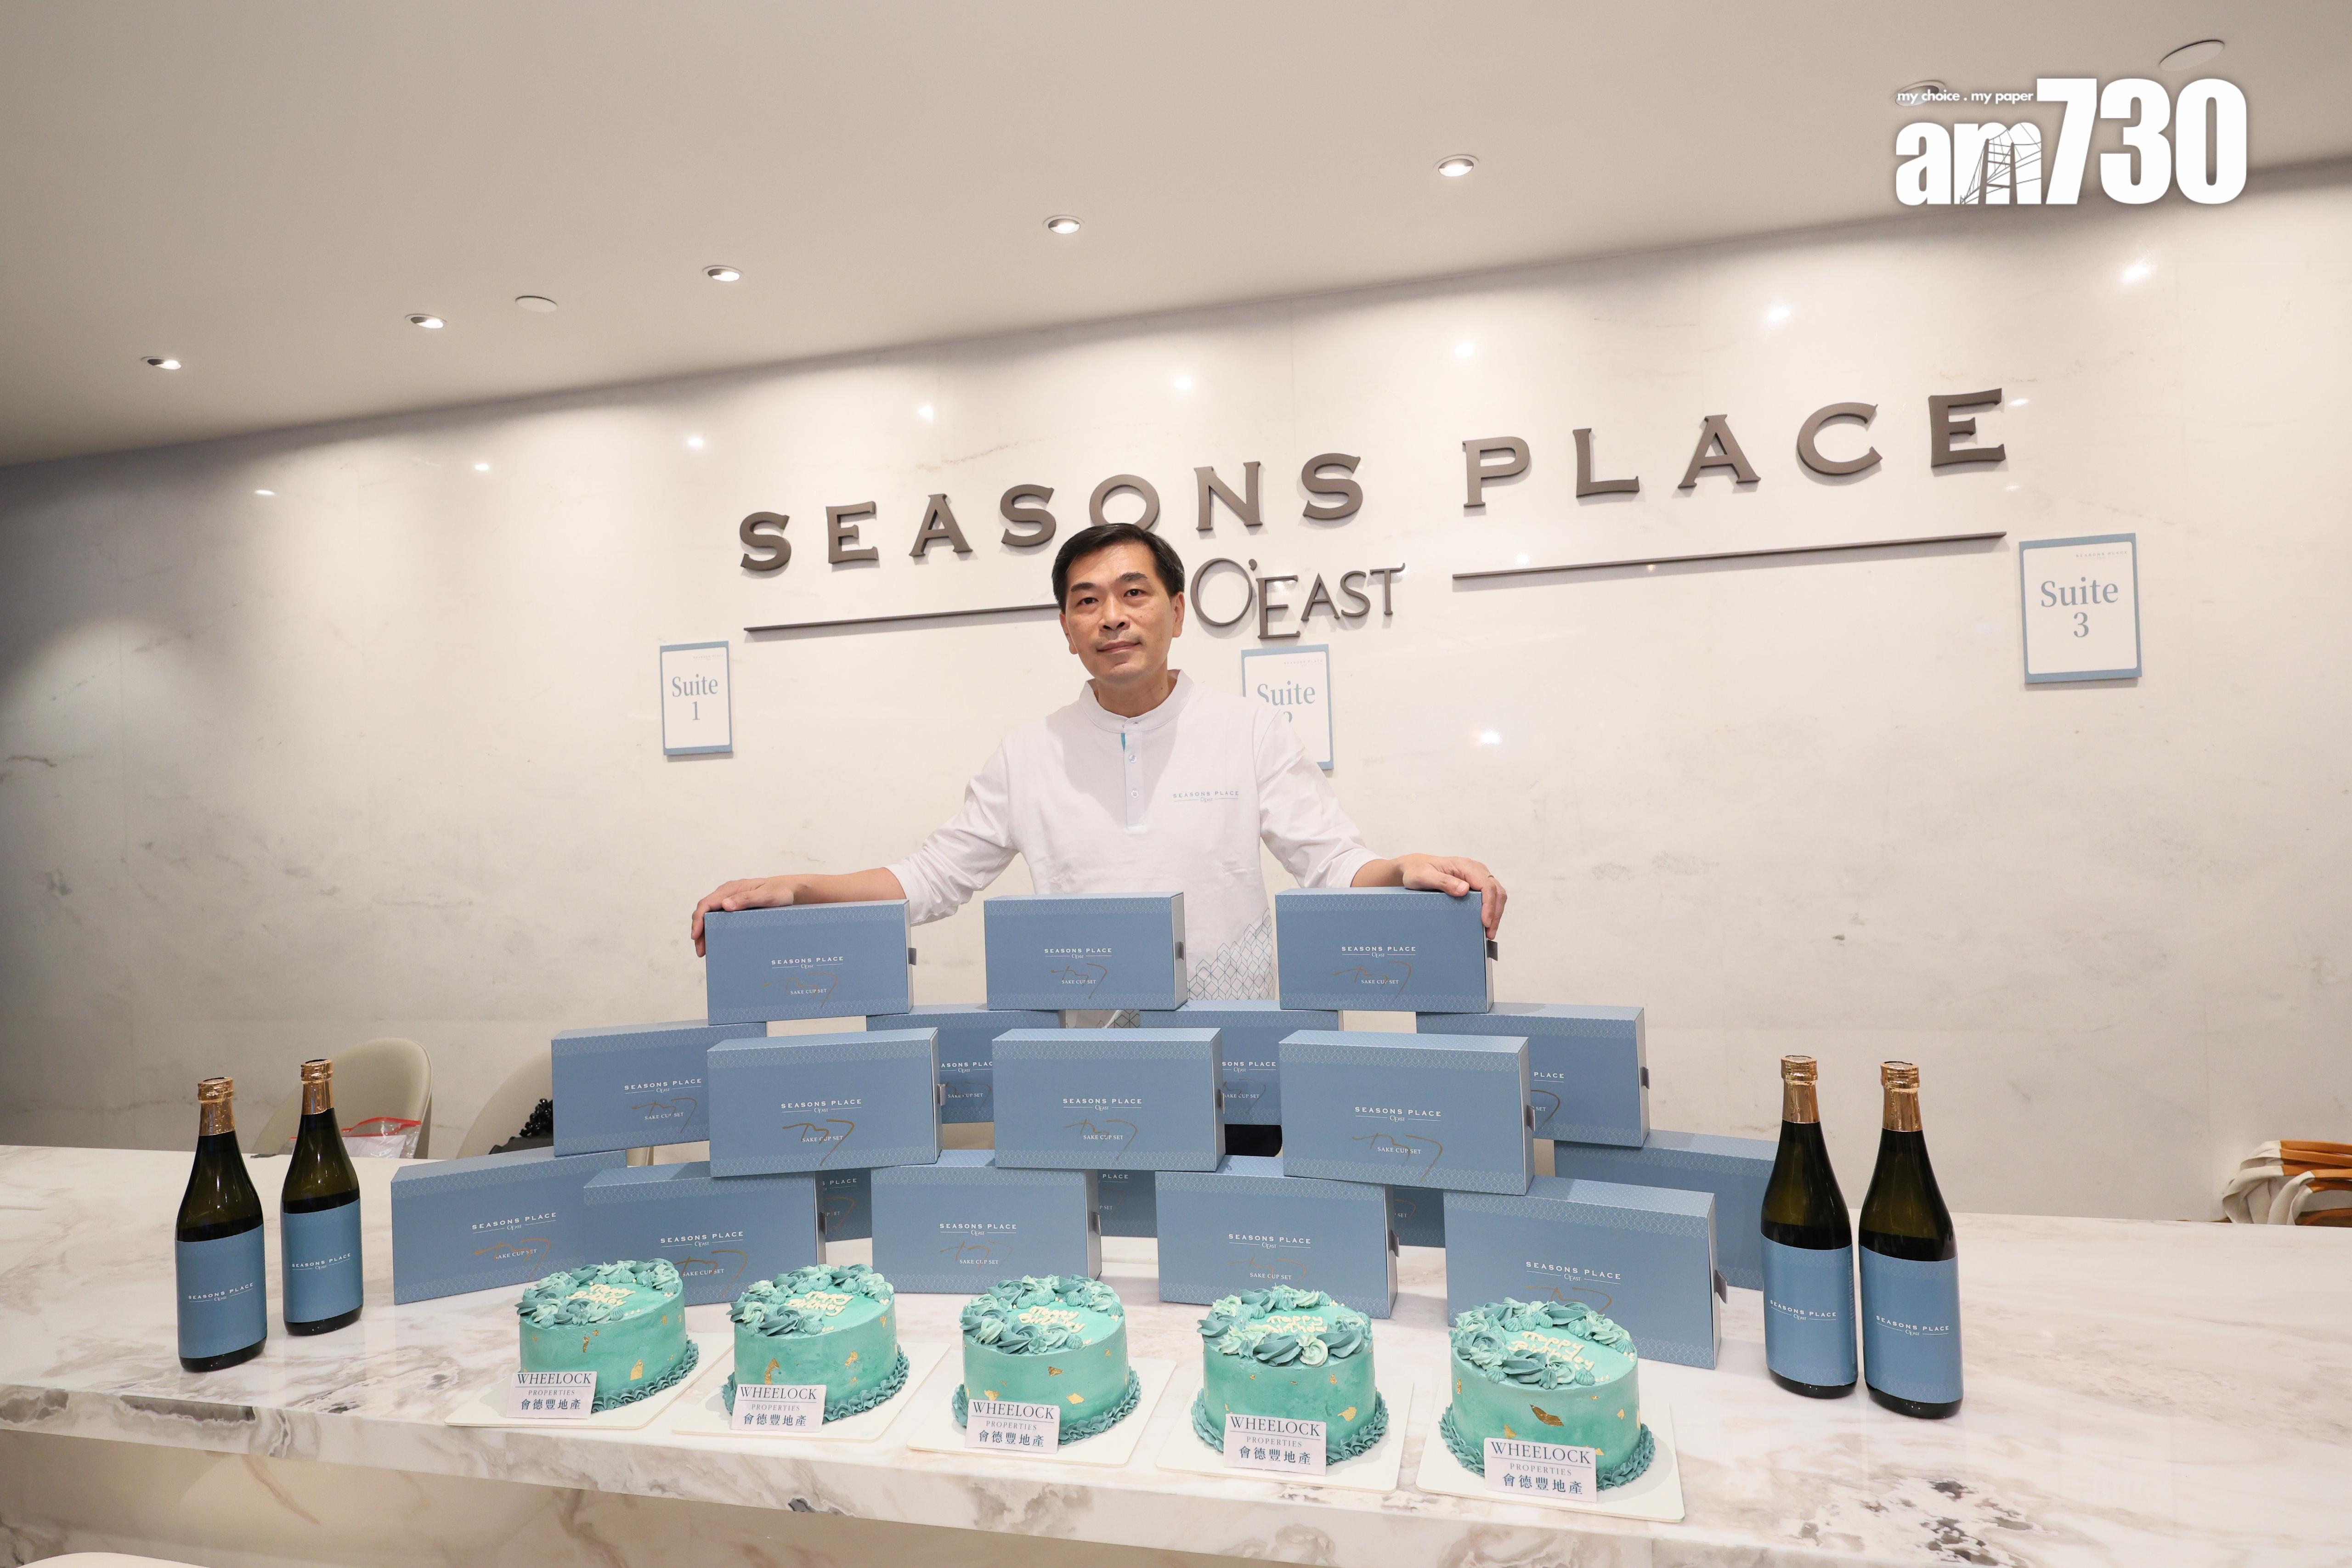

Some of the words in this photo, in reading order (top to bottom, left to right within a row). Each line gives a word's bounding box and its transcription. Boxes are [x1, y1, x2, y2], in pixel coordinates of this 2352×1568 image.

[739, 452, 1364, 571] SEASONS
[1462, 388, 2007, 508] PLACE
[1190, 557, 1406, 639] O'EAST
[2041, 576, 2119, 607] Suite
[2073, 612, 2090, 638] 3
[672, 673, 718, 697] Suite
[1257, 680, 1316, 706] Suite
[692, 701, 700, 721] 1
[624, 1082, 668, 1090] SEASONS
[1355, 1106, 1403, 1115] SEASONS
[472, 1218, 520, 1230] SEASONS
[525, 1212, 557, 1222] PLACE
[661, 1234, 707, 1243] SEASONS
[329, 1252, 351, 1263] PLACE
[1526, 1261, 1578, 1274] SEASONS
[1584, 1269, 1621, 1280] PLACE
[188, 1291, 225, 1300] SEASONS
[229, 1282, 254, 1293] PLACE
[1770, 1299, 1805, 1315] SEASONS
[1876, 1315, 1918, 1330] SEASONS
[517, 1373, 592, 1384] WHEELOCK
[740, 1387, 818, 1399] WHEELOCK
[521, 1399, 581, 1410] 會德豐地產
[973, 1402, 1055, 1419] WHEELOCK
[743, 1413, 807, 1426] 會德豐地產
[986, 1421, 1037, 1430] PROPERTIES
[1230, 1416, 1321, 1437] WHEELOCK
[978, 1430, 1044, 1447] 會德豐地產
[1246, 1436, 1302, 1448] PROPERTIES
[1239, 1446, 1311, 1465] 會德豐地產
[1491, 1441, 1591, 1464] WHEELOCK
[1510, 1463, 1572, 1476] PROPERTIES
[1503, 1473, 1583, 1495] 會德豐地產
